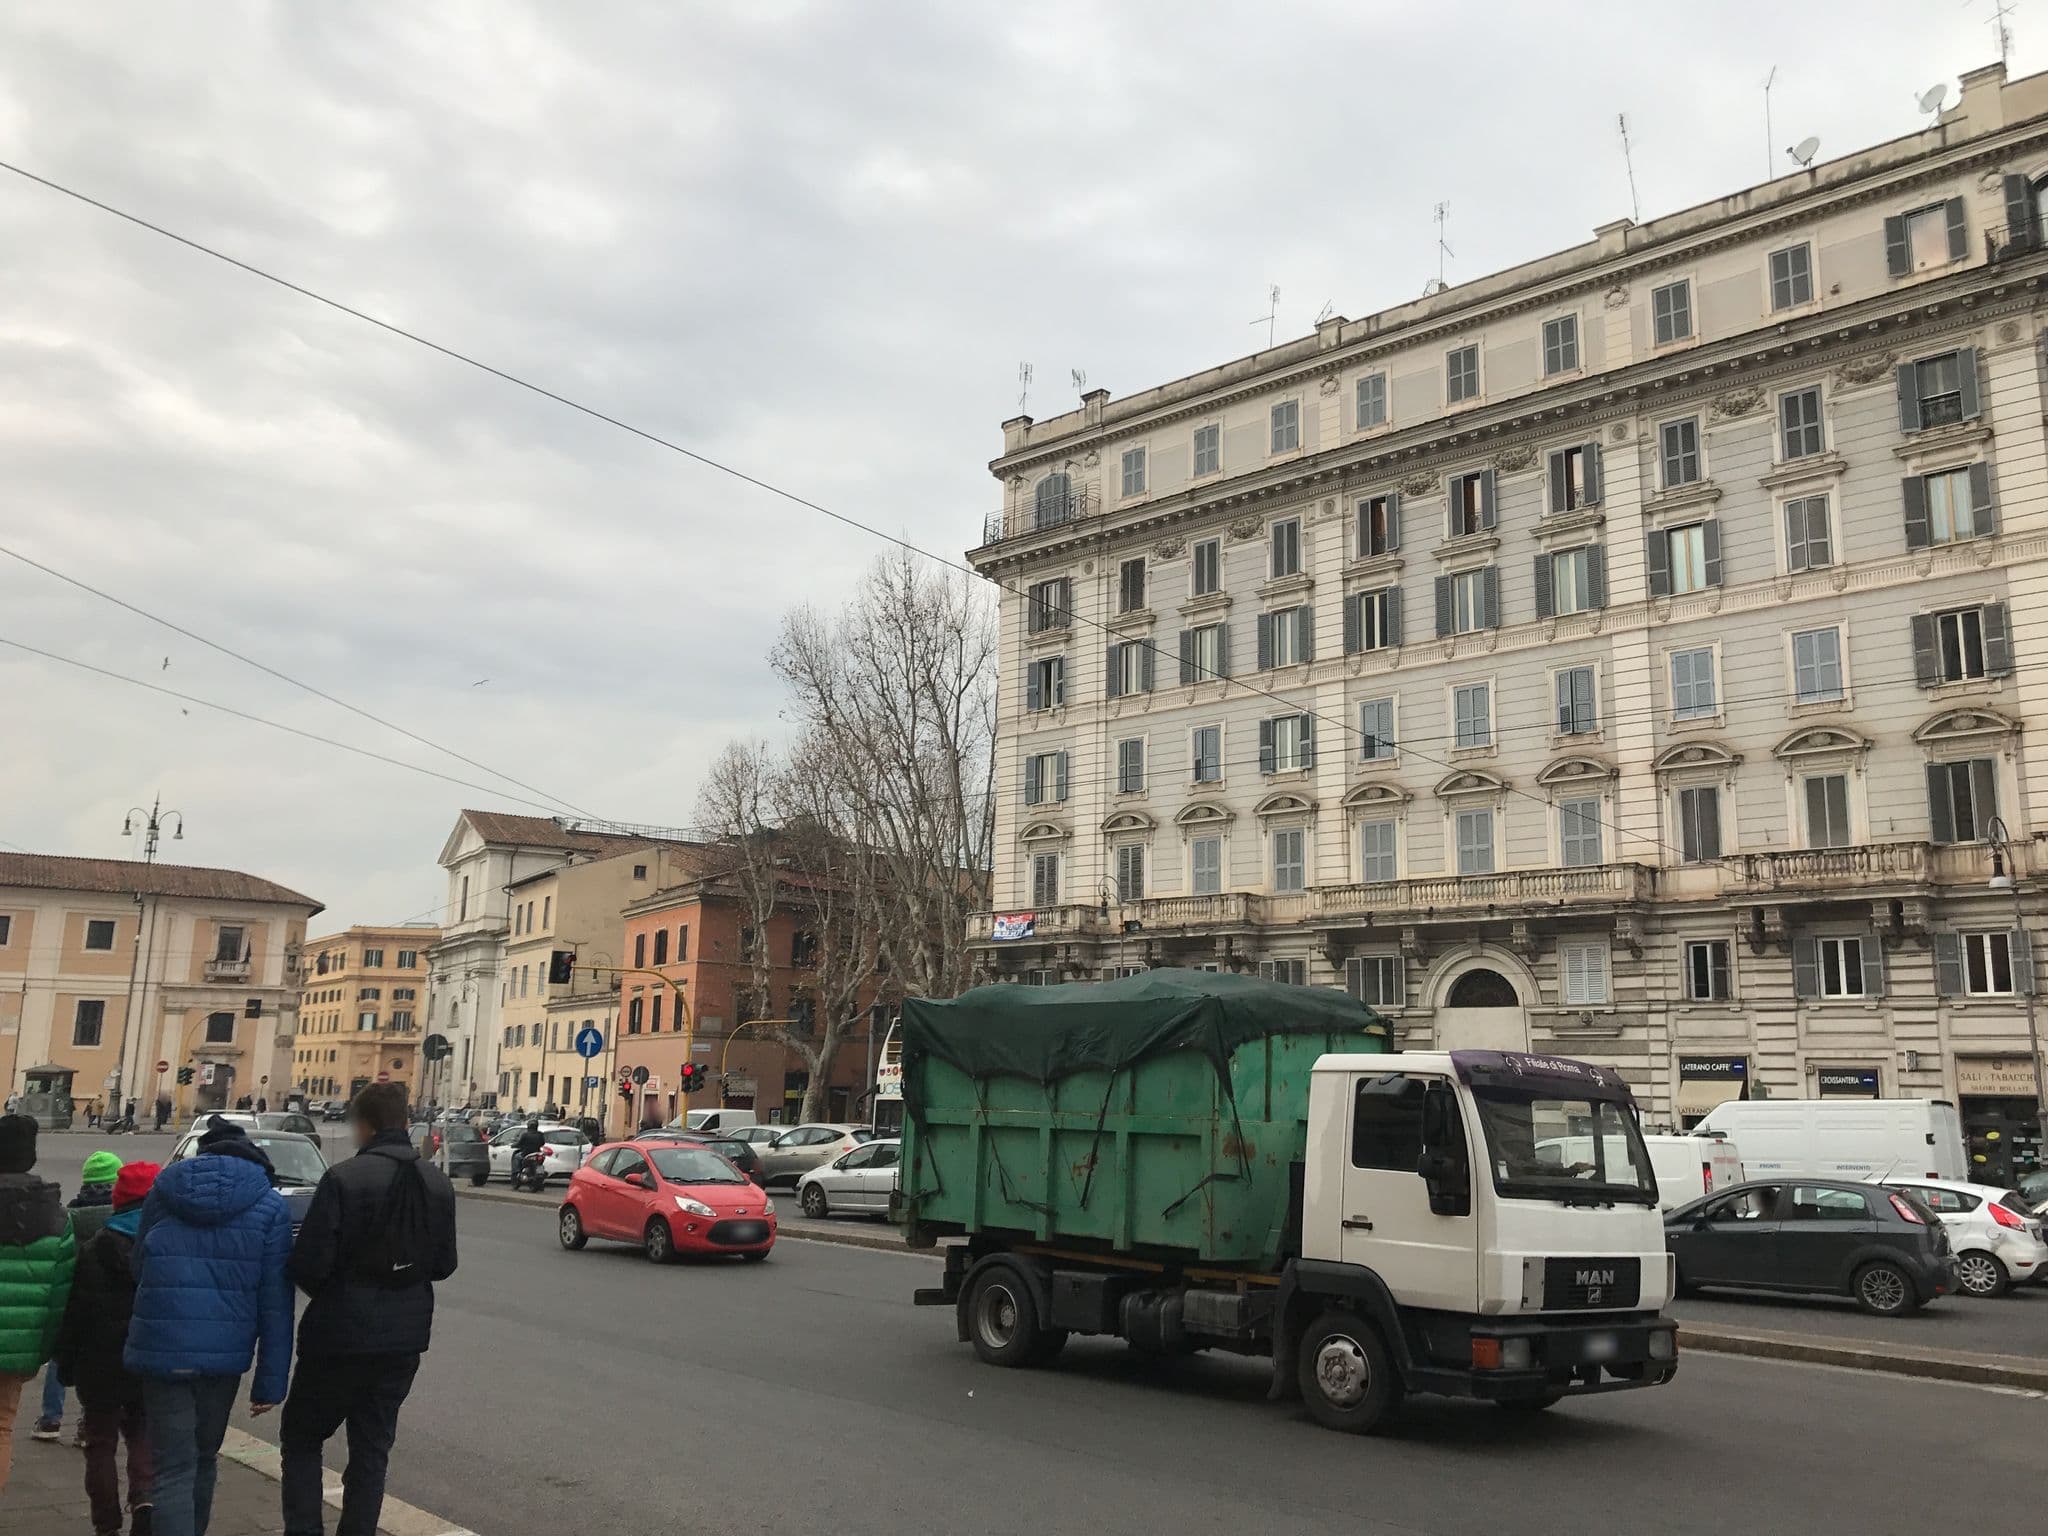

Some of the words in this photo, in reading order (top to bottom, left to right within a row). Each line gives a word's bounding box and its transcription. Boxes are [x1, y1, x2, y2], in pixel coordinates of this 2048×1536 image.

[1524, 1057, 1549, 1069] Filiale
[1557, 1061, 1581, 1074] Roma
[1681, 1063, 1711, 1071] LATERANO
[588, 1077, 597, 1087] P
[1820, 1075, 1860, 1085] CROISSANTERIA
[1960, 1072, 1981, 1081] SALI
[1991, 1073, 2034, 1082] TABACCH
[1575, 1270, 1614, 1285] MAN
